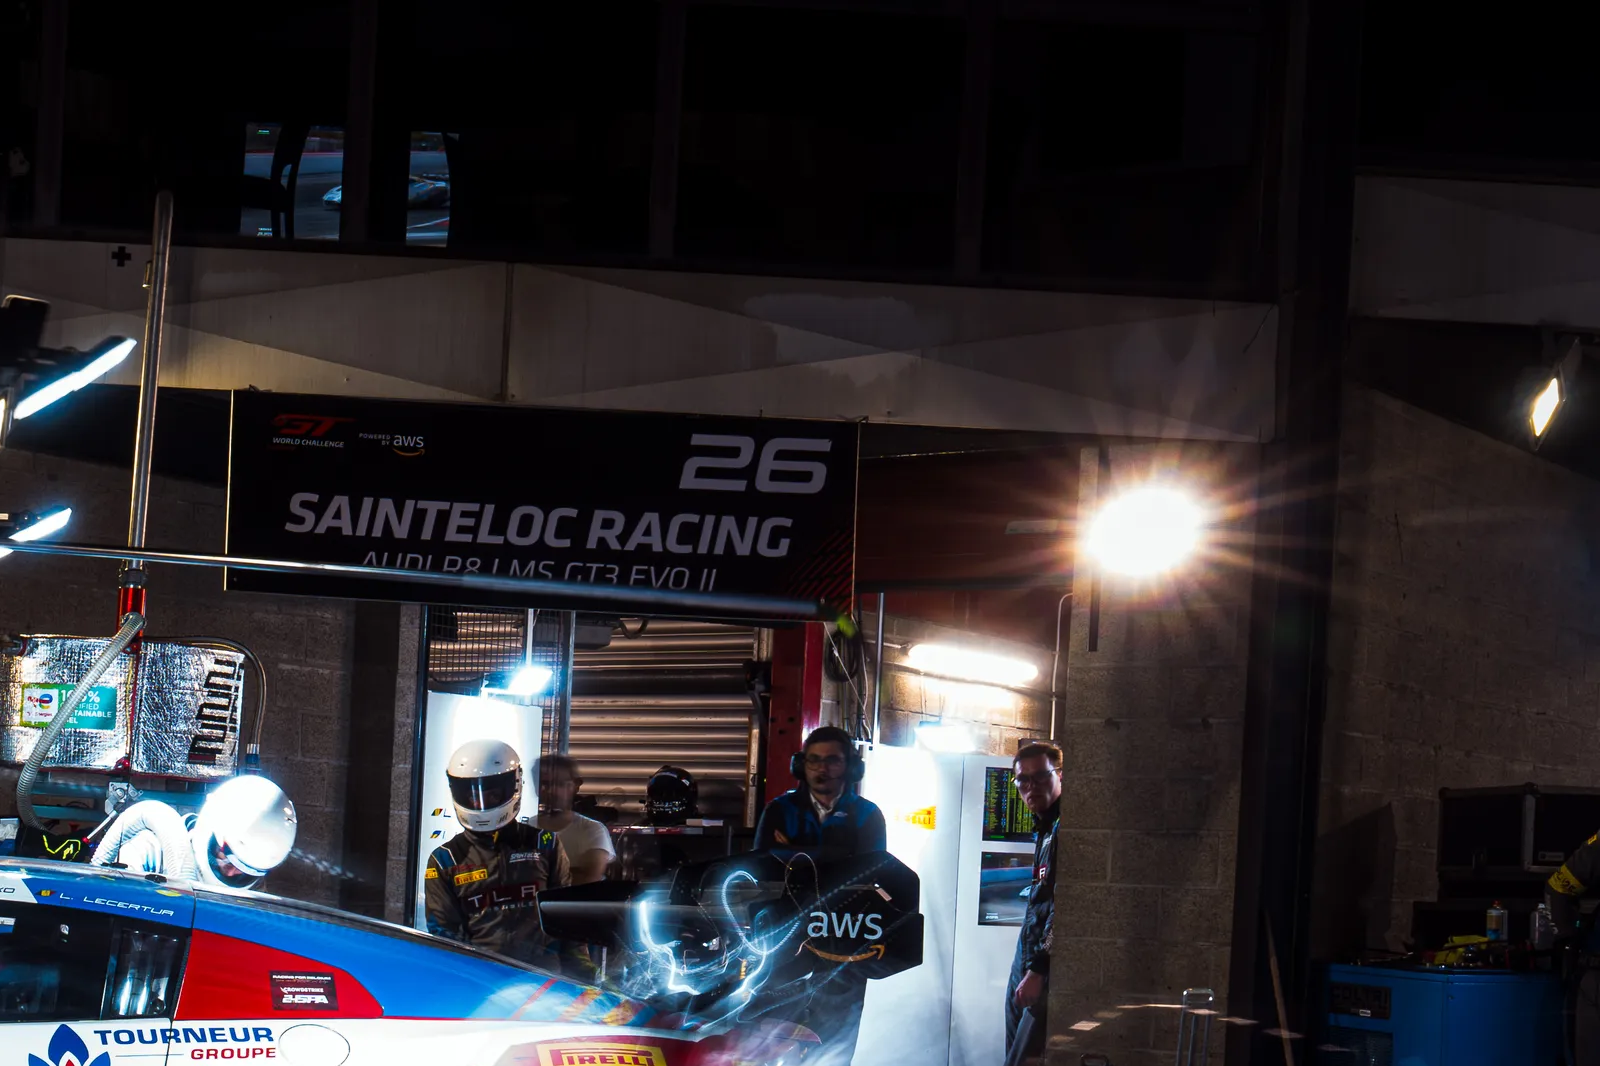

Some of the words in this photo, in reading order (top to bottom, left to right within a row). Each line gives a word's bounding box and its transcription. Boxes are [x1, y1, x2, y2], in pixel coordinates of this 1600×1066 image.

[272, 436, 300, 446] WORLD
[301, 438, 345, 448] CHALLENGE
[359, 432, 391, 440] POWERED
[393, 433, 425, 448] aws
[679, 433, 833, 494] 26
[285, 491, 578, 548] SAINTELOC
[586, 508, 794, 558] RACING
[629, 565, 690, 591] EVO
[60, 689, 100, 703] 1%
[83, 896, 175, 917] LECERTUA
[807, 911, 883, 940] aws
[94, 1027, 275, 1046] TOURNEUR
[190, 1047, 277, 1060] GROUPE
